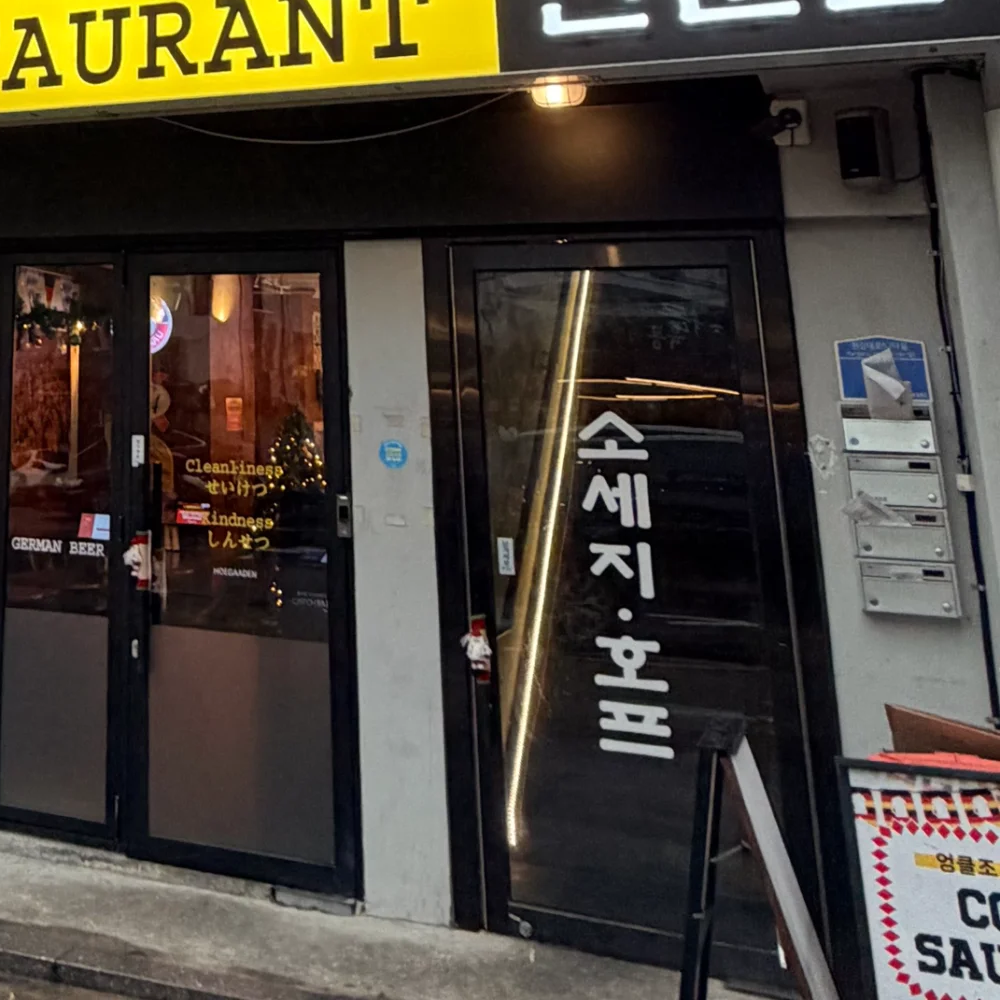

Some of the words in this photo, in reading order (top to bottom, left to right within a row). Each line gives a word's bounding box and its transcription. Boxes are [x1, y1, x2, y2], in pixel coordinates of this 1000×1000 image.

[186, 459, 284, 477] Cleanliness
[206, 479, 268, 497] せいけつ
[202, 511, 274, 530] Kindness
[11, 536, 62, 554] GERMAN
[69, 541, 105, 558] BEER
[208, 530, 270, 549] しんせつ
